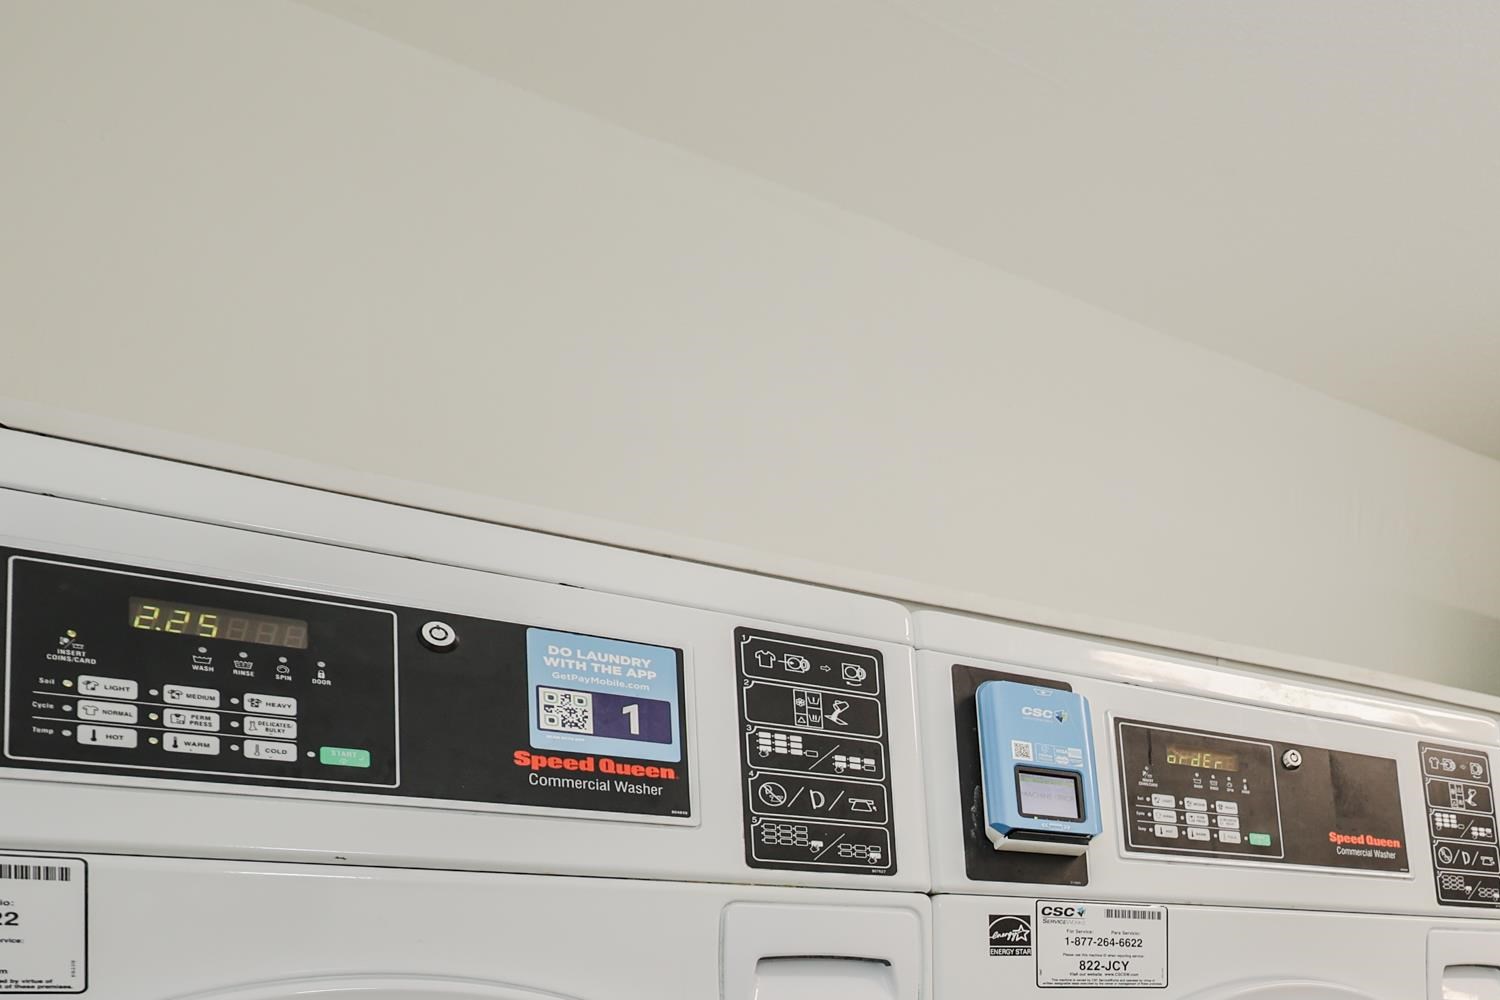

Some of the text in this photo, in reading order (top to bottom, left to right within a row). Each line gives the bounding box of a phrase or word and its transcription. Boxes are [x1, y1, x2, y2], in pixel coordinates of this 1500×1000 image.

[133, 605, 218, 638] 2.25
[57, 648, 86, 657] INSERT
[547, 645, 652, 668] DO LAUNDRY
[46, 653, 97, 665] COINS/CARD
[192, 664, 214, 672] WASH
[543, 656, 657, 680] WITH THE APP
[232, 669, 255, 677] RINSE
[38, 677, 55, 685] Soil
[311, 678, 332, 686] DOOR
[551, 671, 650, 691] GetPayMobile.com
[103, 684, 130, 692] LIGHT
[185, 693, 216, 701] MEDIUM
[31, 701, 55, 710] Cycle
[102, 709, 133, 718] NORMAL
[1021, 706, 1053, 718] CSC
[622, 703, 640, 735] 1
[189, 720, 213, 728] PRESS
[32, 726, 54, 735] Temp
[105, 733, 124, 741] HOT
[183, 740, 211, 748] WARM
[264, 747, 288, 755] COLD
[331, 749, 358, 758] START
[513, 750, 675, 779] Speed Queen
[528, 772, 663, 796] Commercial Washer
[751, 816, 757, 824] 5
[1328, 831, 1401, 848] Speed Queen
[1336, 846, 1396, 860] Commercial Washer
[1041, 906, 1075, 917] CSC
[1065, 937, 1143, 947] 1-877-264-6622
[1079, 960, 1129, 971] 822-JCY
